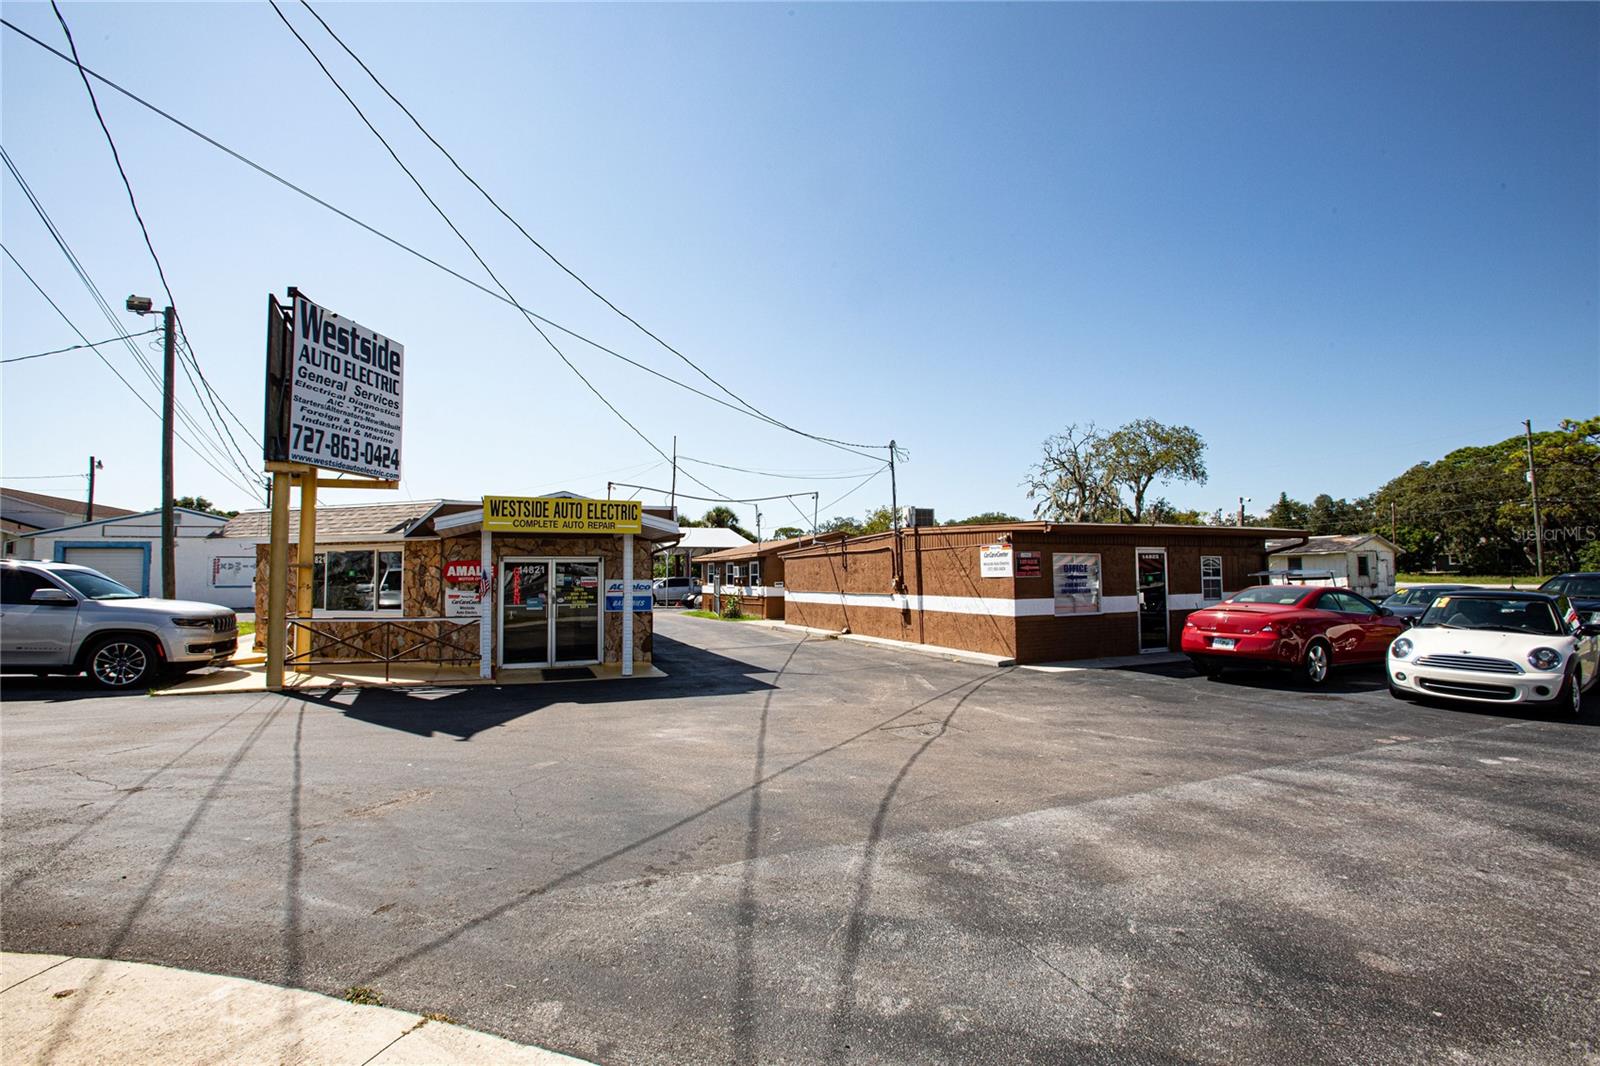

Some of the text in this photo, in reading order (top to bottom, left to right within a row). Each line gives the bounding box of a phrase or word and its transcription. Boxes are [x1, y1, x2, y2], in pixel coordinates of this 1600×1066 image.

[300, 299, 400, 376] Westside
[298, 344, 399, 396] AUTO ELECTRIC
[294, 380, 400, 418] Electrical Diagnostics
[297, 366, 399, 410] General Services
[300, 406, 340, 422] Foreign
[353, 419, 395, 437] Domestic
[353, 406, 376, 418] Tires
[301, 415, 351, 433] Industrial
[363, 431, 394, 444] Marine
[293, 423, 400, 470] 727-863-0424
[291, 453, 400, 479] www.westsideautoelectric.com
[490, 500, 638, 521] WESTSIDE AUTO ELECTRIC
[512, 519, 616, 529] COMPLETE AUTO REPAIR
[446, 565, 494, 577] AMALE
[519, 566, 545, 574] 14821
[1063, 564, 1088, 573] OFFICE
[609, 583, 651, 591] AClco
